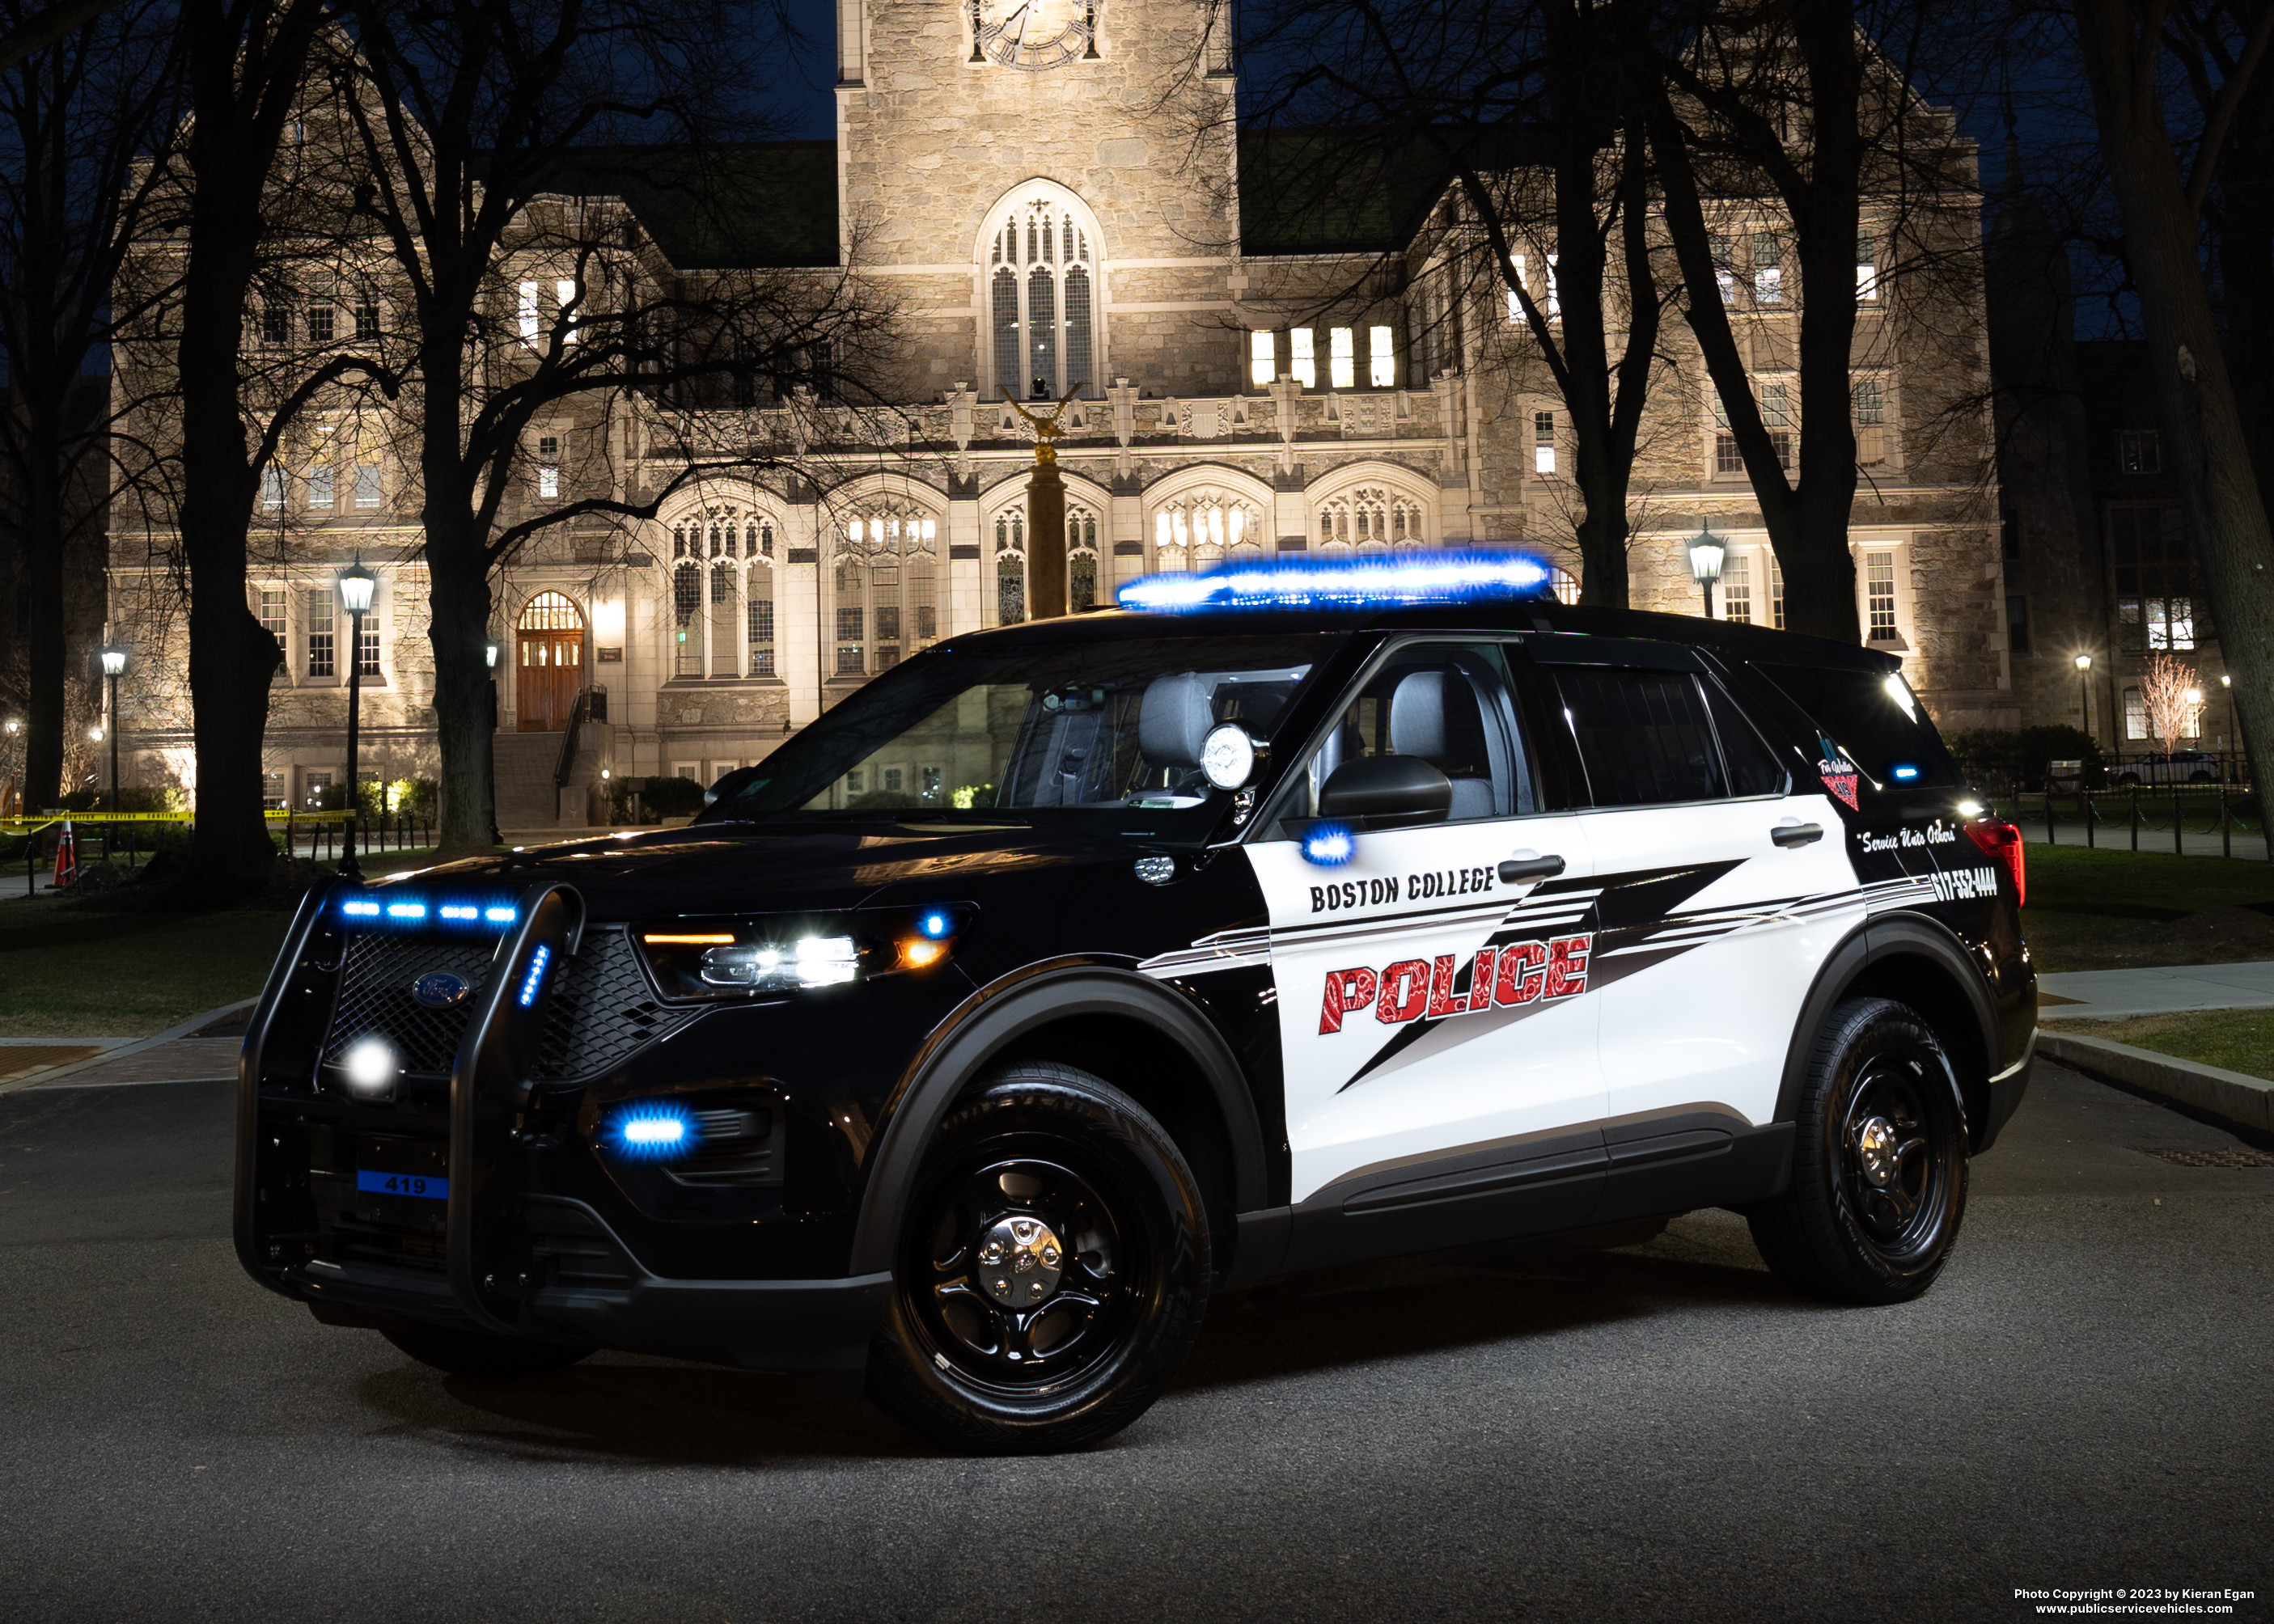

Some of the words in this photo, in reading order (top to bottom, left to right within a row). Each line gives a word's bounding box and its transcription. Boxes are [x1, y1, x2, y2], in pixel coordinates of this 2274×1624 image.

[1836, 780, 1853, 797] 419
[1310, 877, 1400, 913] BOSTON
[1408, 865, 1495, 899] COLLEGE
[1930, 867, 1997, 902] 617-552-4444
[1318, 933, 1593, 1036] POLICE
[384, 1176, 426, 1195] 419
